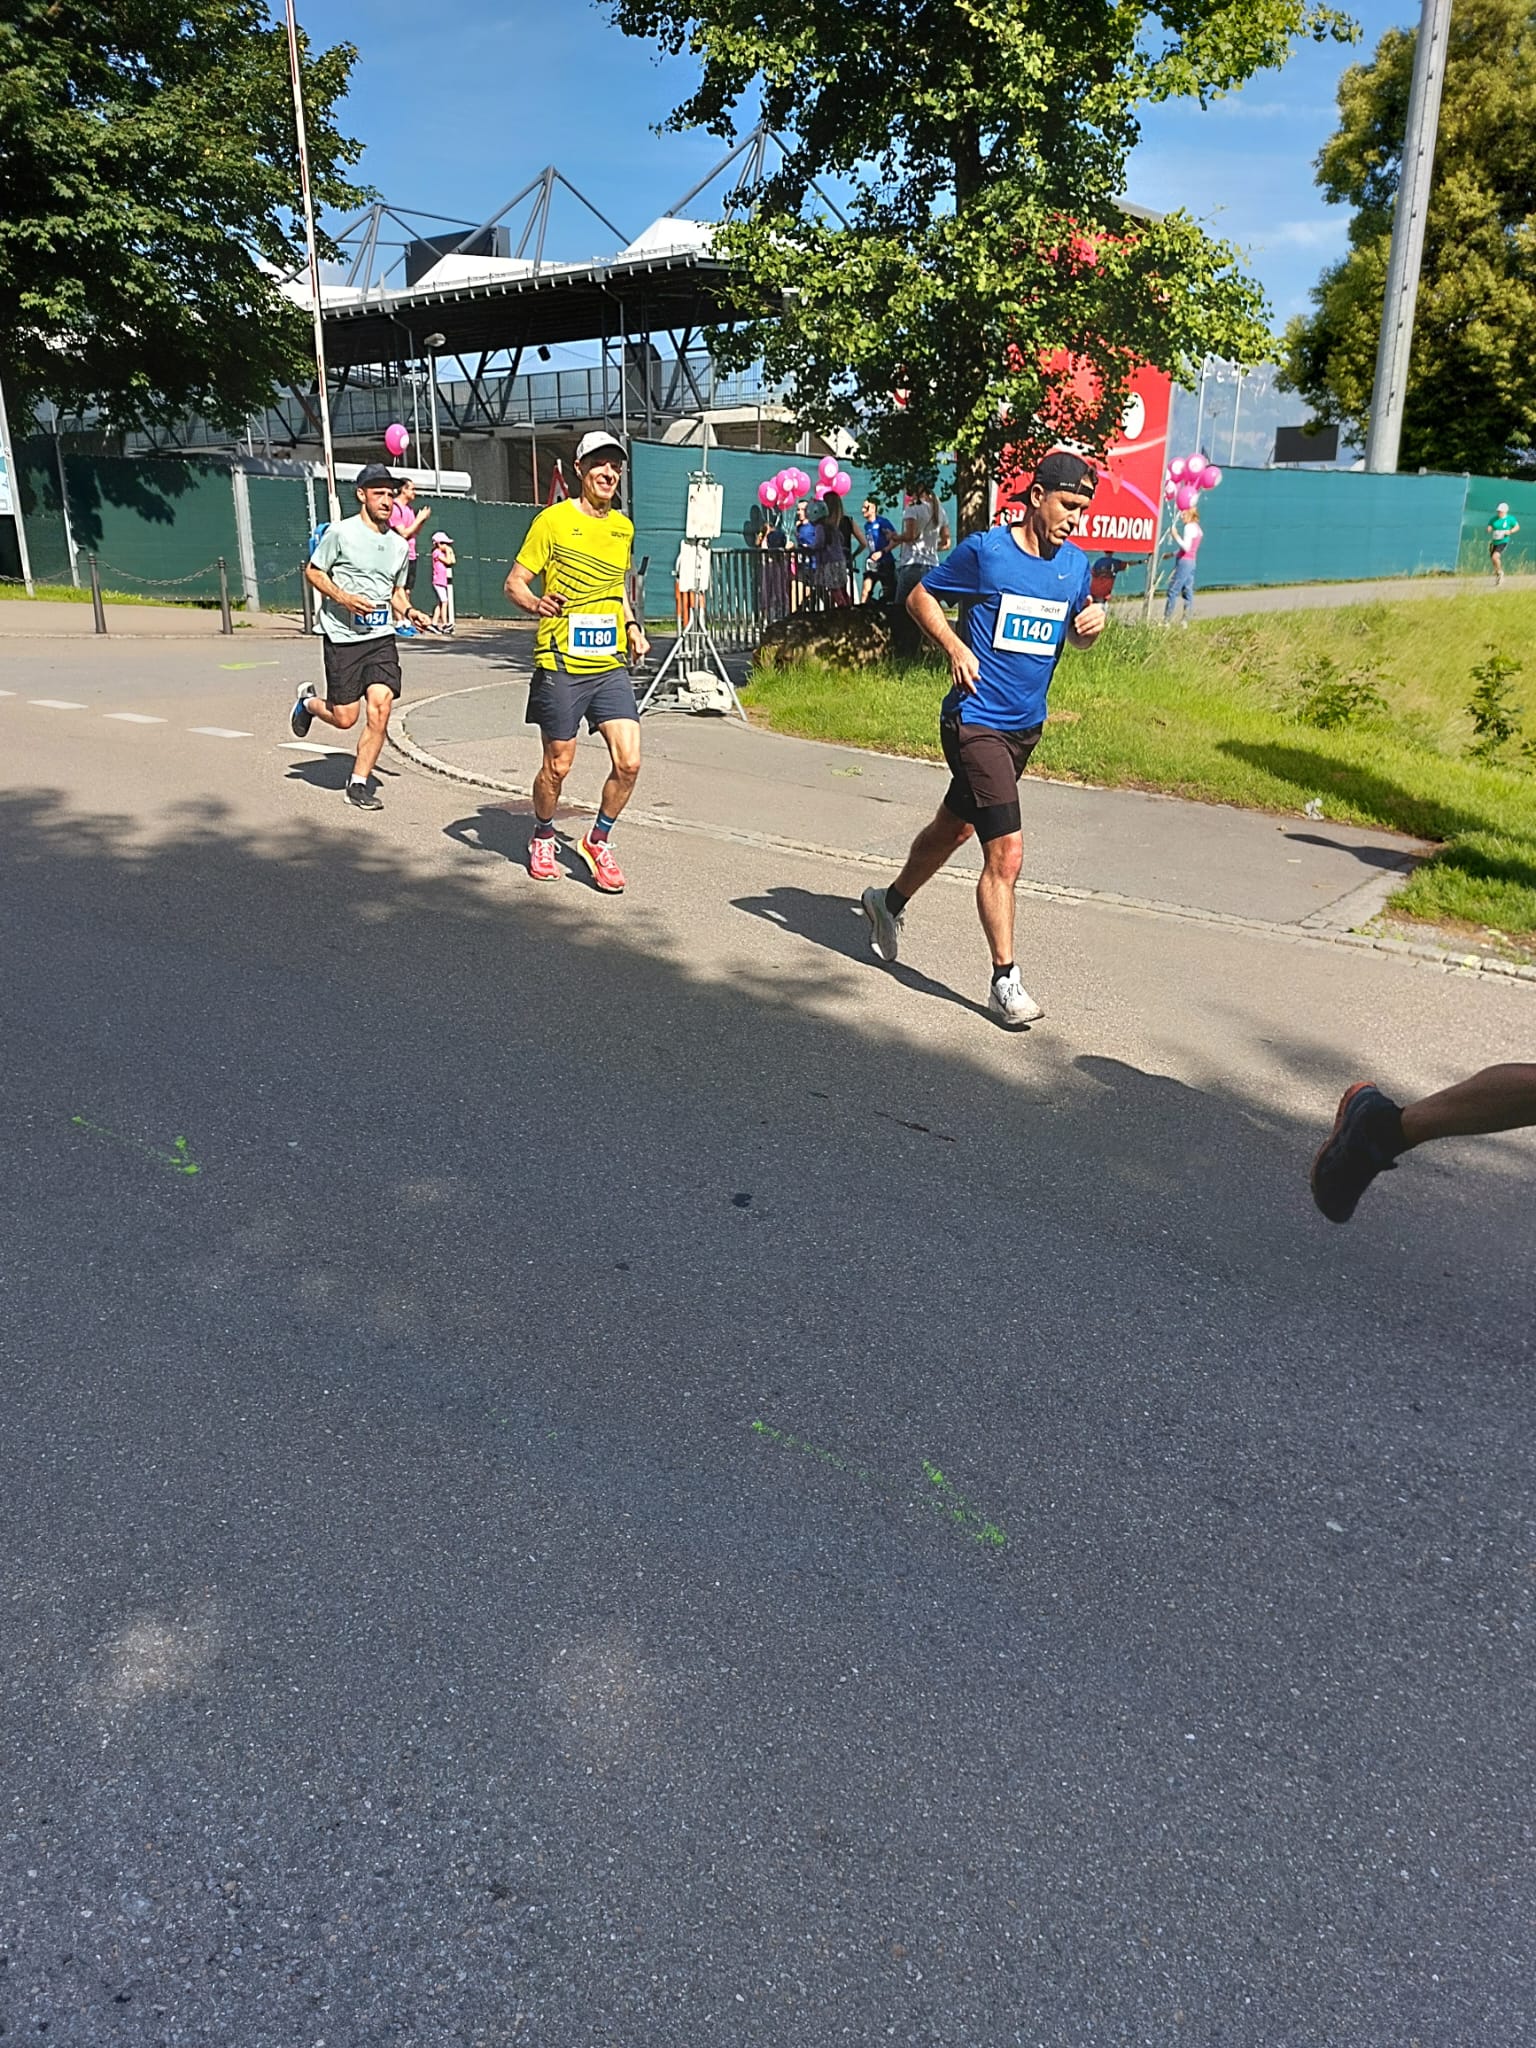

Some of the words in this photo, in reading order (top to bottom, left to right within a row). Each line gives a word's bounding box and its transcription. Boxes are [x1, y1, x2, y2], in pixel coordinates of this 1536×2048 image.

[1092, 514, 1153, 540] STADION
[580, 630, 612, 646] 1180
[1012, 617, 1053, 641] 1140
